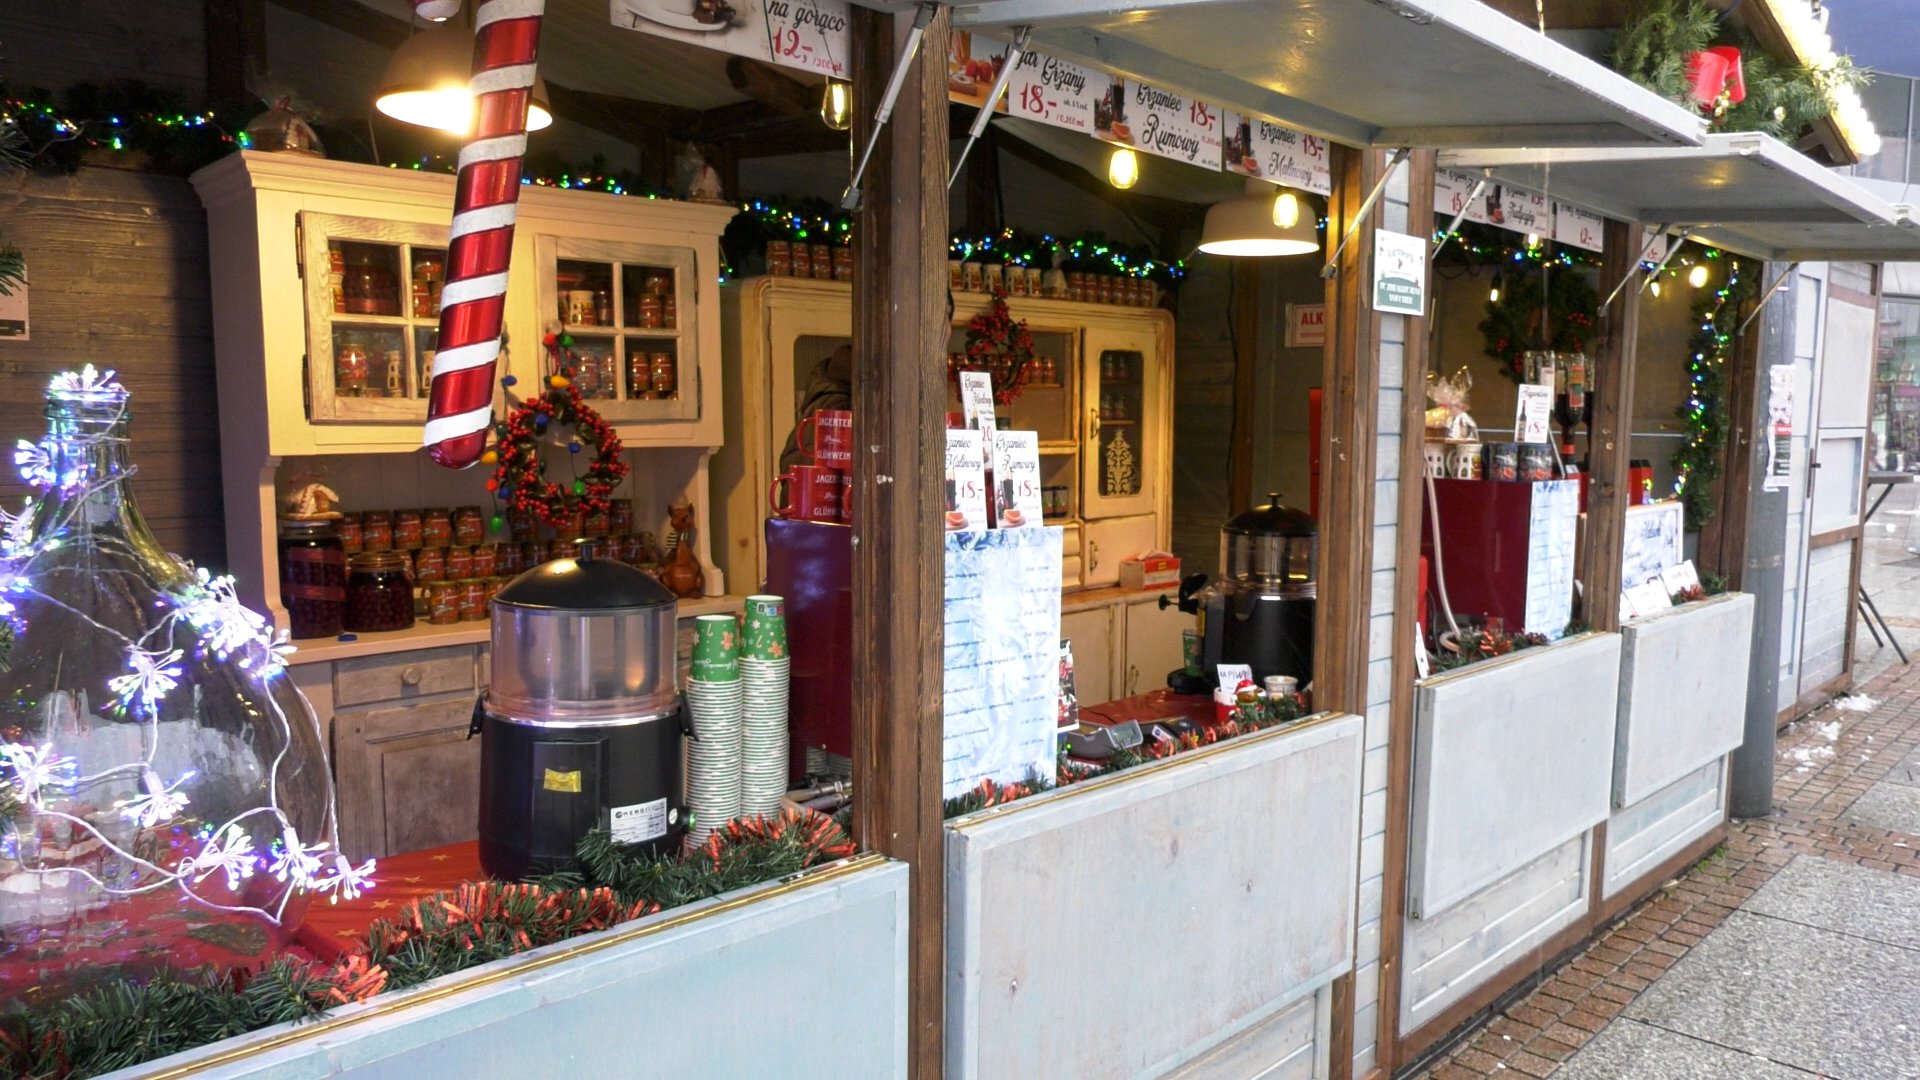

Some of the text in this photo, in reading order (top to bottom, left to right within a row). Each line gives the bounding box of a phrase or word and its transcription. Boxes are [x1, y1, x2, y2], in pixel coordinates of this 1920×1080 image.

[768, 0, 846, 35] na gorąco
[1041, 56, 1086, 96] Grzany
[1136, 83, 1182, 112] Grzaniec
[1142, 113, 1199, 161] Rumowy
[1301, 312, 1324, 325] ALK
